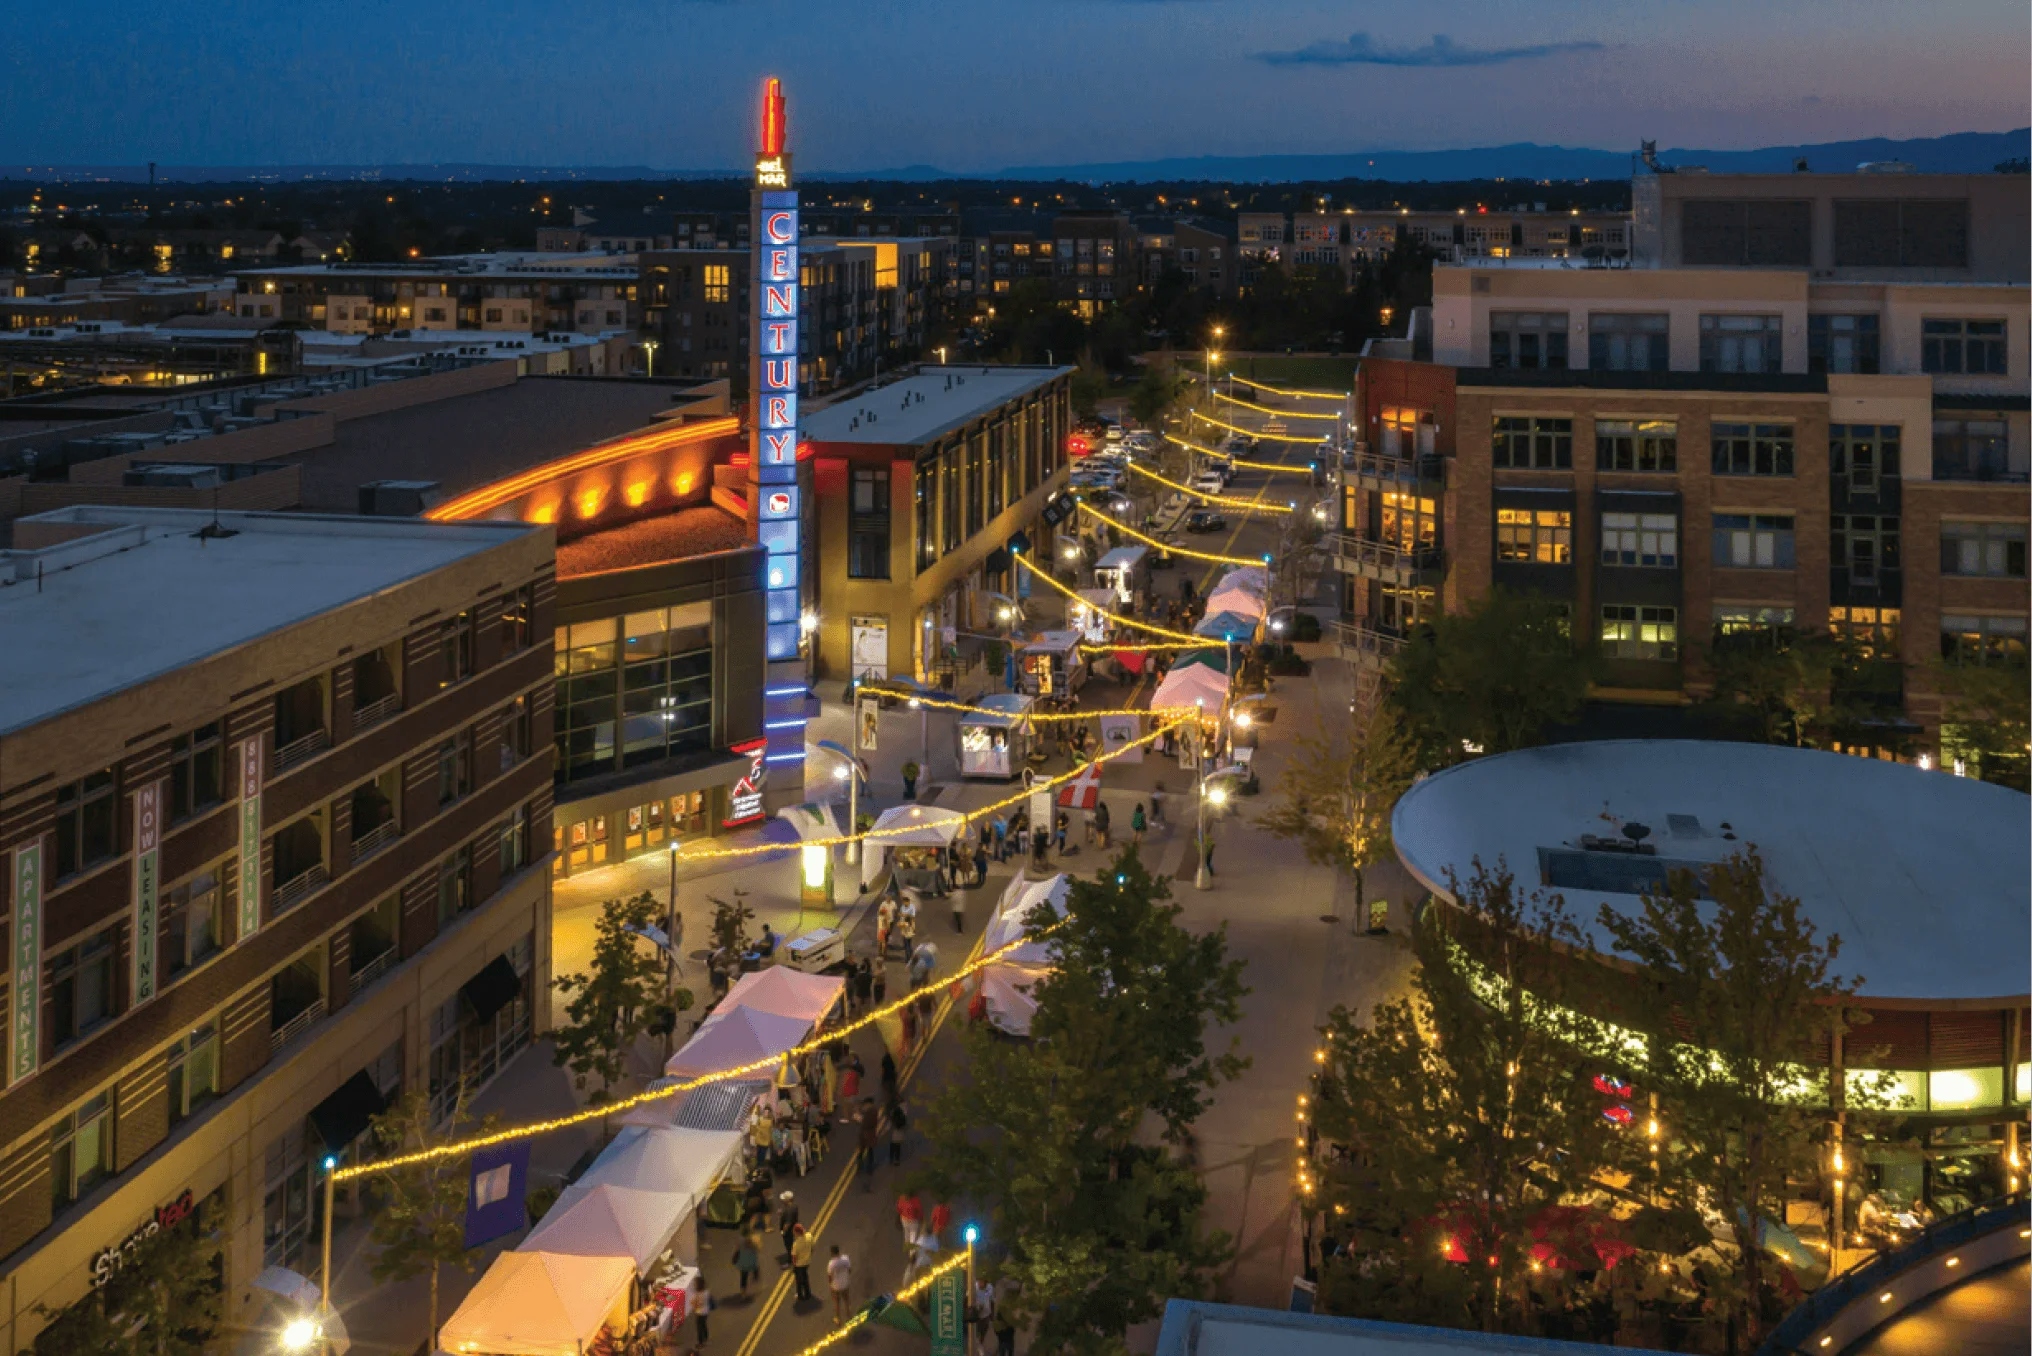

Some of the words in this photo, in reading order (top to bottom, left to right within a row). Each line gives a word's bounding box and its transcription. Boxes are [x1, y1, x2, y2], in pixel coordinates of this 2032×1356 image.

[766, 212, 791, 462] CENTURY
[140, 789, 154, 849] NOW
[19, 857, 33, 1073] APARTMENTS
[139, 858, 152, 999] LEASING
